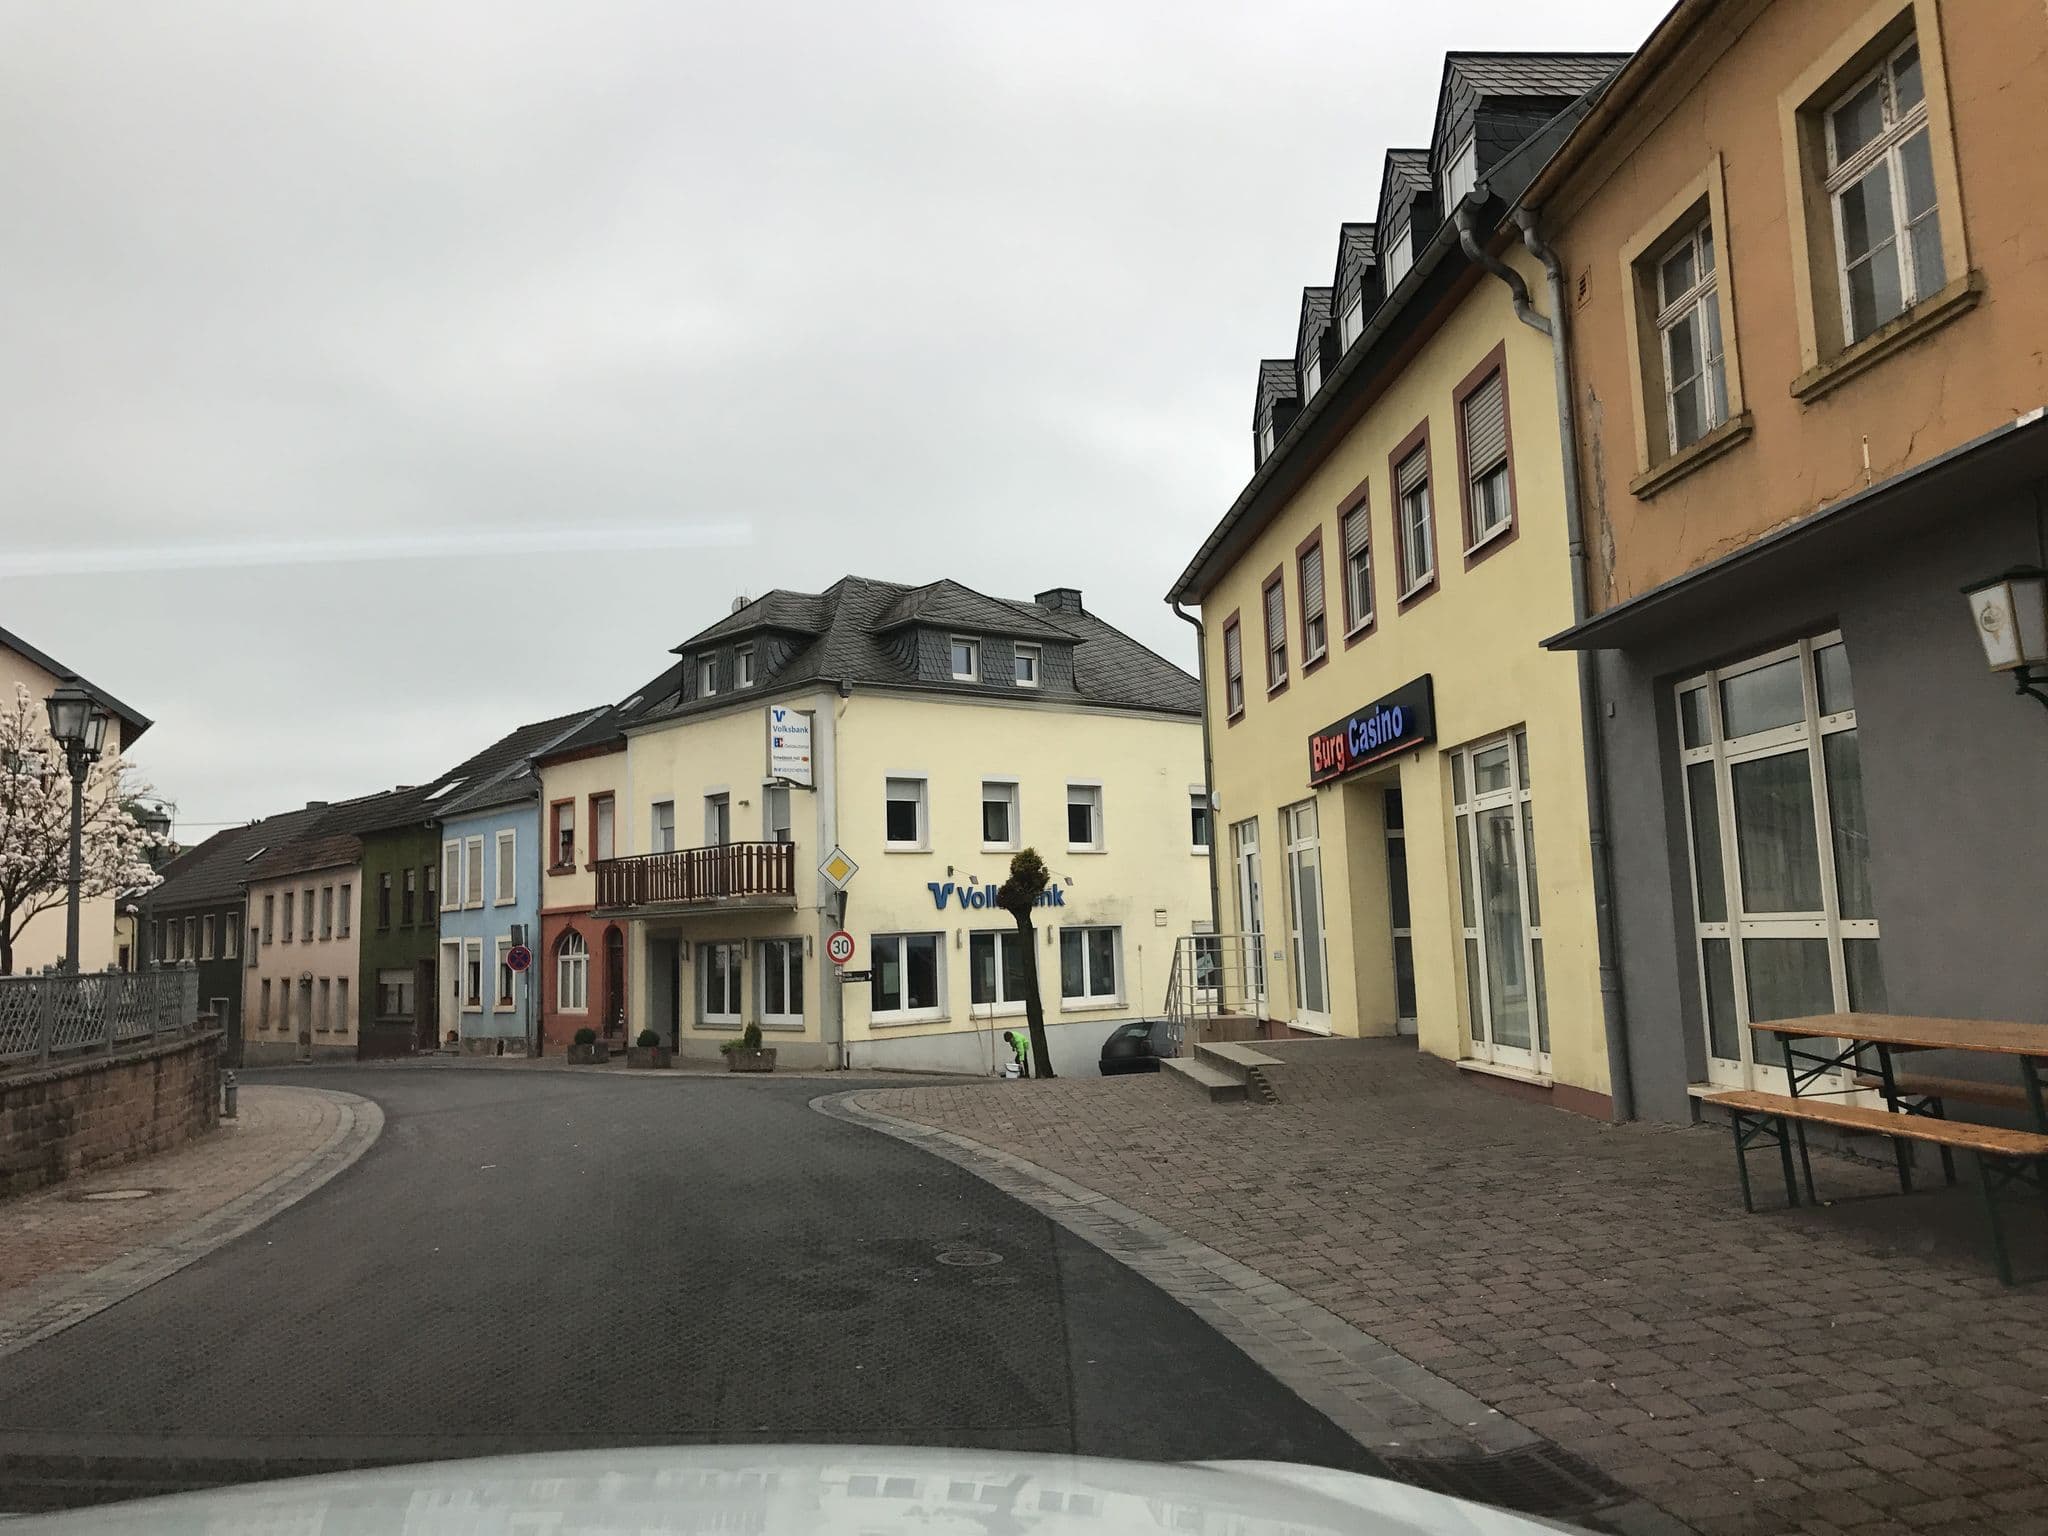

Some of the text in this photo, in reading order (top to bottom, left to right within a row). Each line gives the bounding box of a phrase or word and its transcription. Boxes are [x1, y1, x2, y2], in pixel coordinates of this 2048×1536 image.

[772, 725, 809, 734] Volksbank
[1312, 703, 1403, 772] Burg Casino
[832, 939, 849, 955] 30
